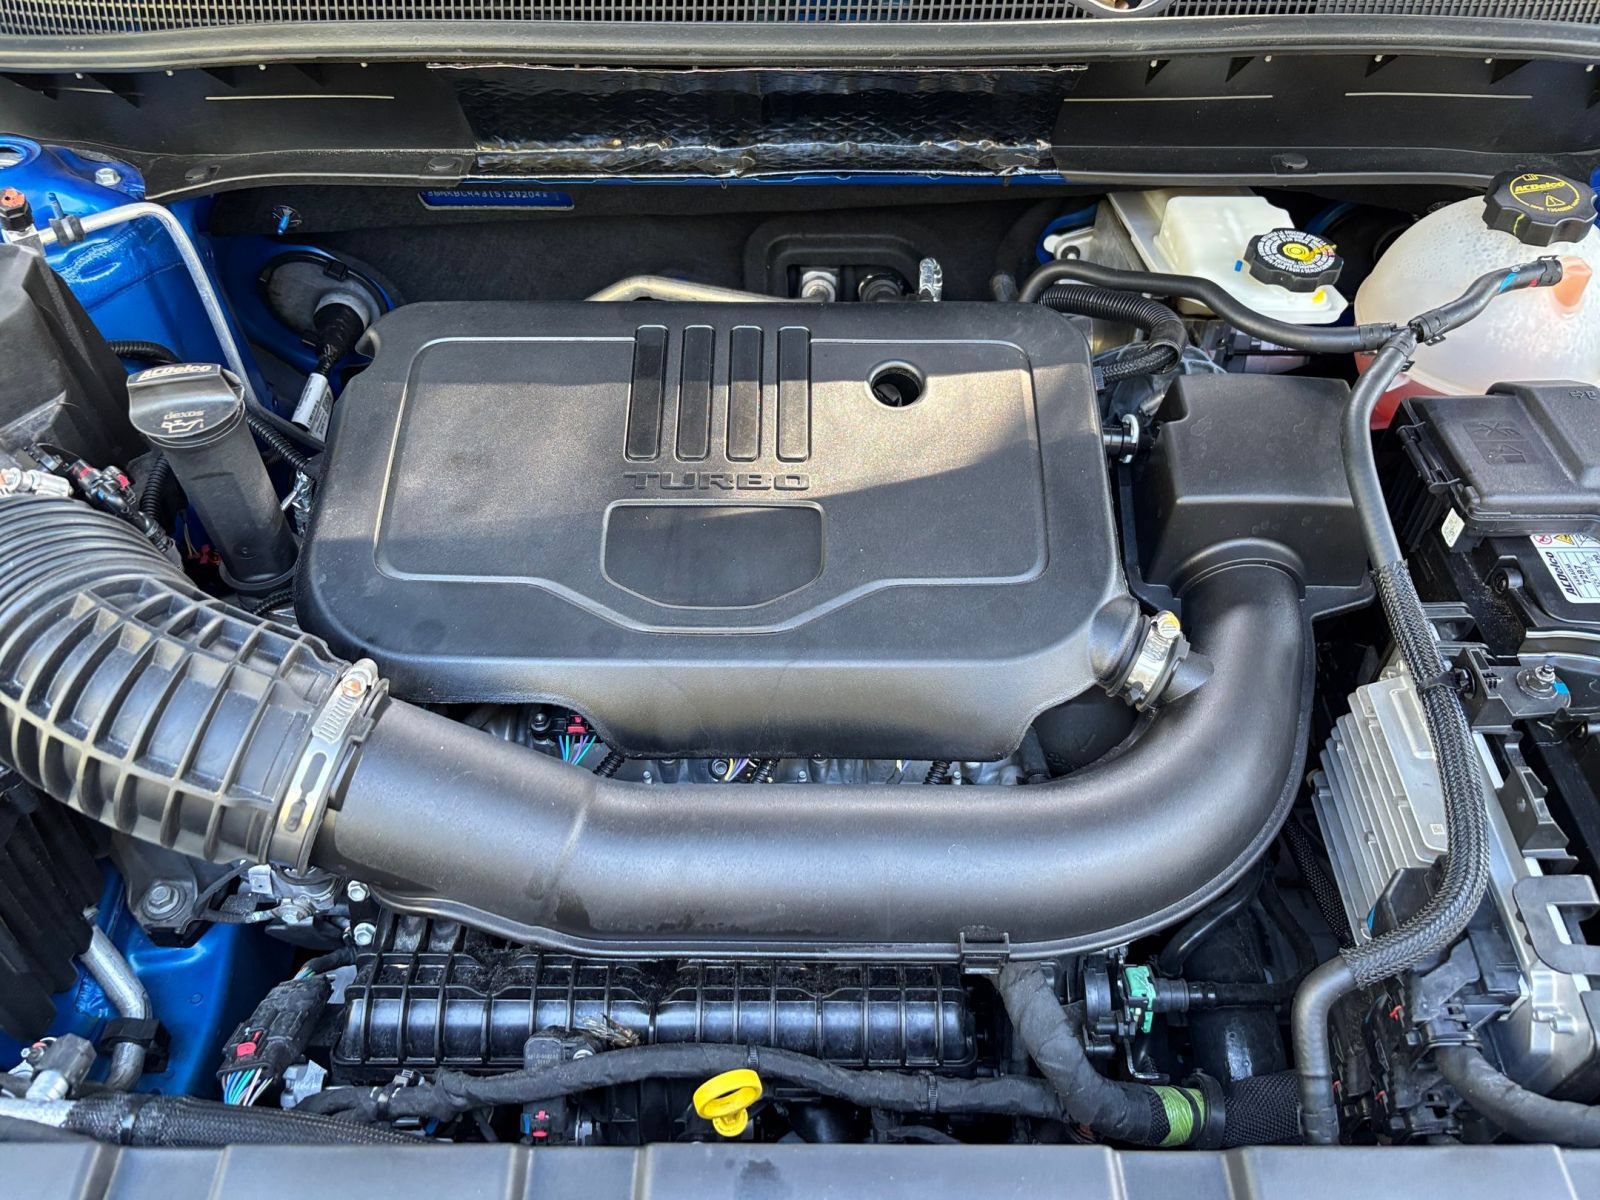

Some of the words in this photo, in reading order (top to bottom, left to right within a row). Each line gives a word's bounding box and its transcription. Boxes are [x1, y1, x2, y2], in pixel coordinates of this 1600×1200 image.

[1514, 181, 1565, 192] ACDelco
[137, 364, 212, 382] ACDelco
[163, 410, 204, 420] dexos
[623, 472, 810, 490] TURBO
[1545, 551, 1578, 596] ACDelco
